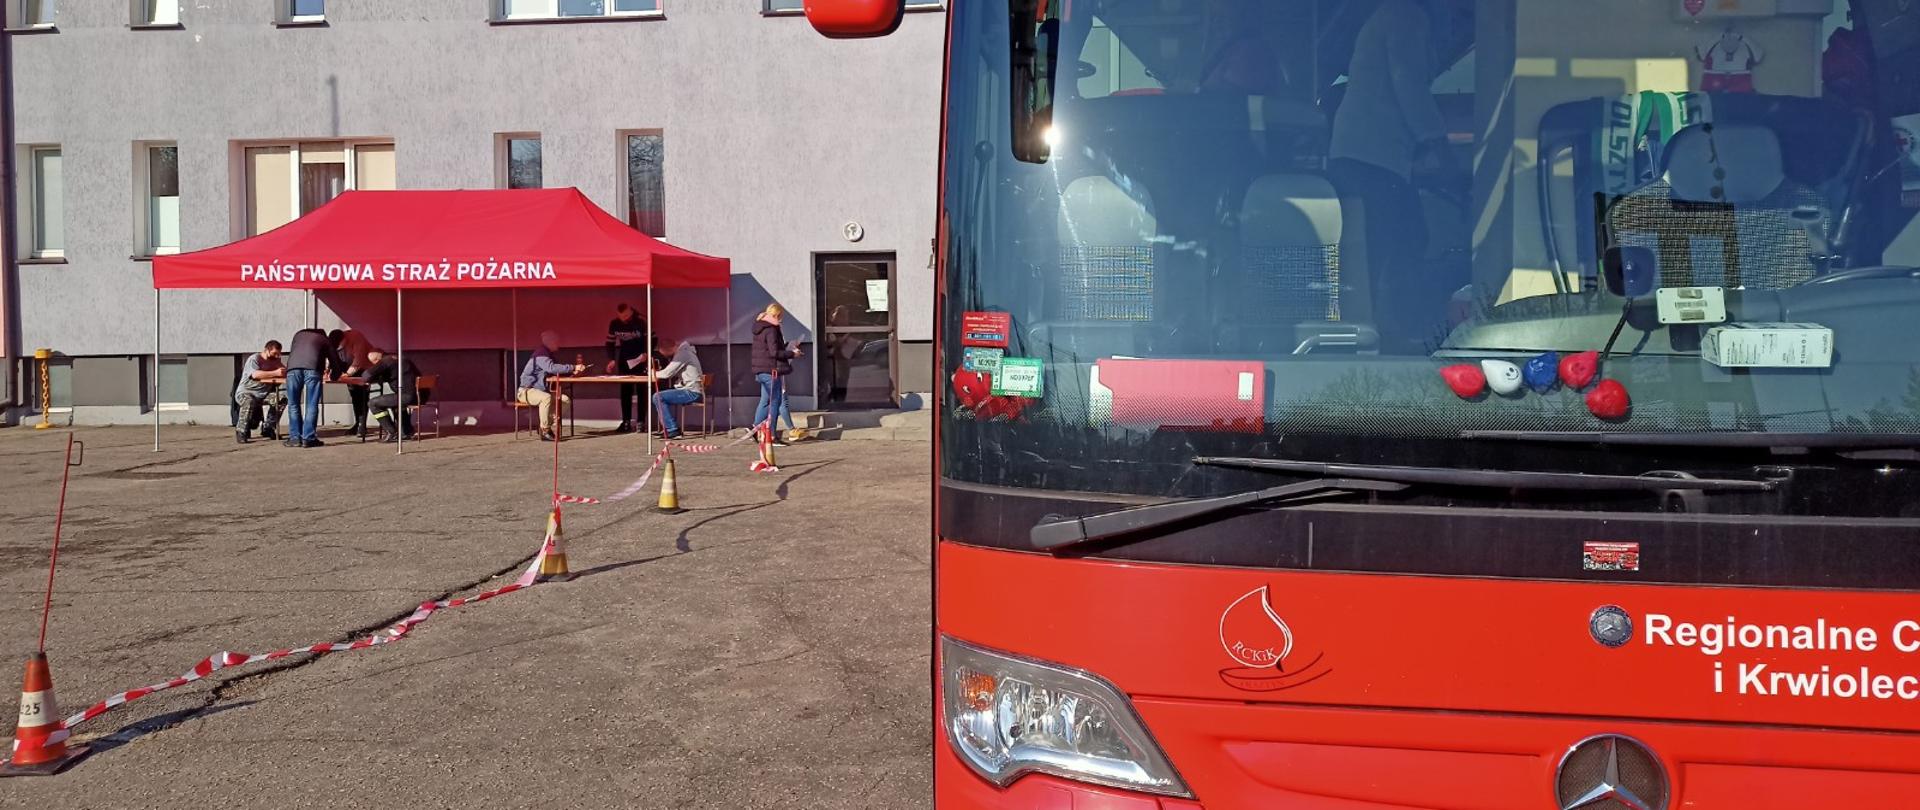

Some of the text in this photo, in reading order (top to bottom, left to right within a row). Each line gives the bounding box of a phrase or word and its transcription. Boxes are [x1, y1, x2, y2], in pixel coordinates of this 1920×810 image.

[241, 256, 557, 282] PAŃSTWOWA STRAŻ POŻARNA
[1644, 613, 1878, 656] Regionalne
[1232, 641, 1278, 661] RCKiK
[1713, 661, 1920, 700] i Krwiolec
